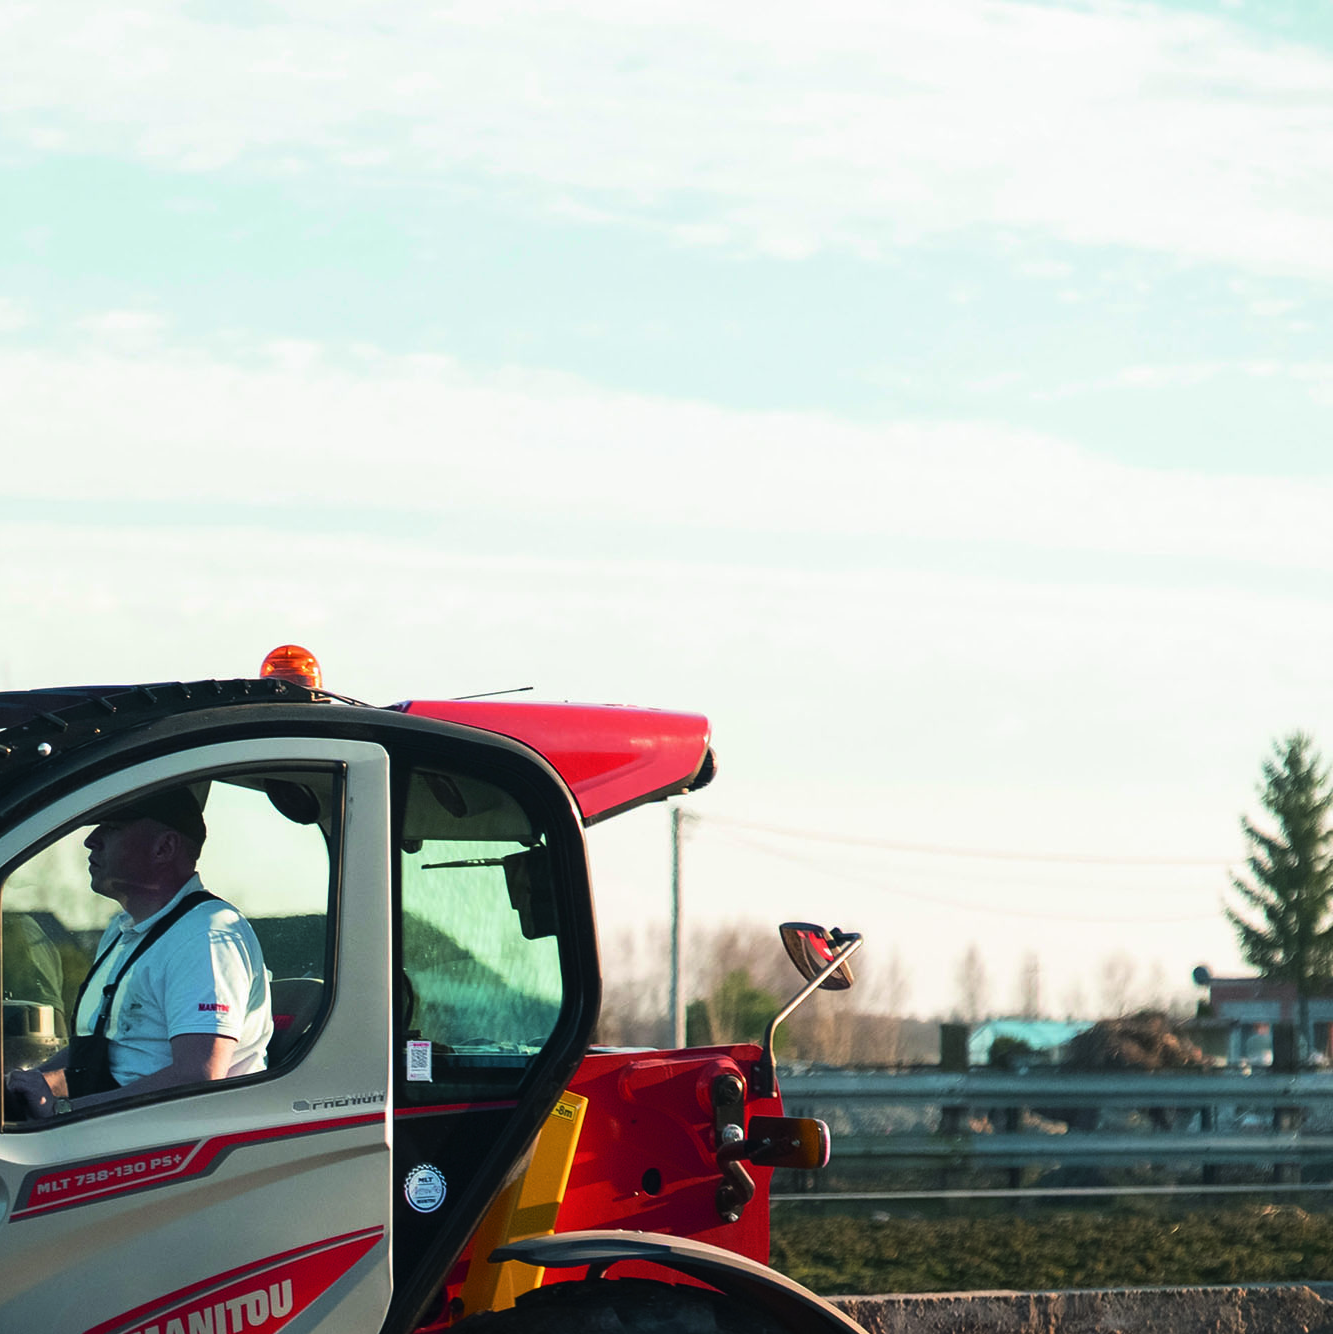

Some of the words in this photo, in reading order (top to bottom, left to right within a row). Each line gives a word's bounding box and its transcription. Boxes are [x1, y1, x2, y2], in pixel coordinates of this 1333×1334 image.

[311, 1090, 386, 1110] PREMIUM
[37, 1177, 71, 1195] MLT
[75, 1162, 146, 1186] 738-130
[150, 1153, 182, 1170] PS+
